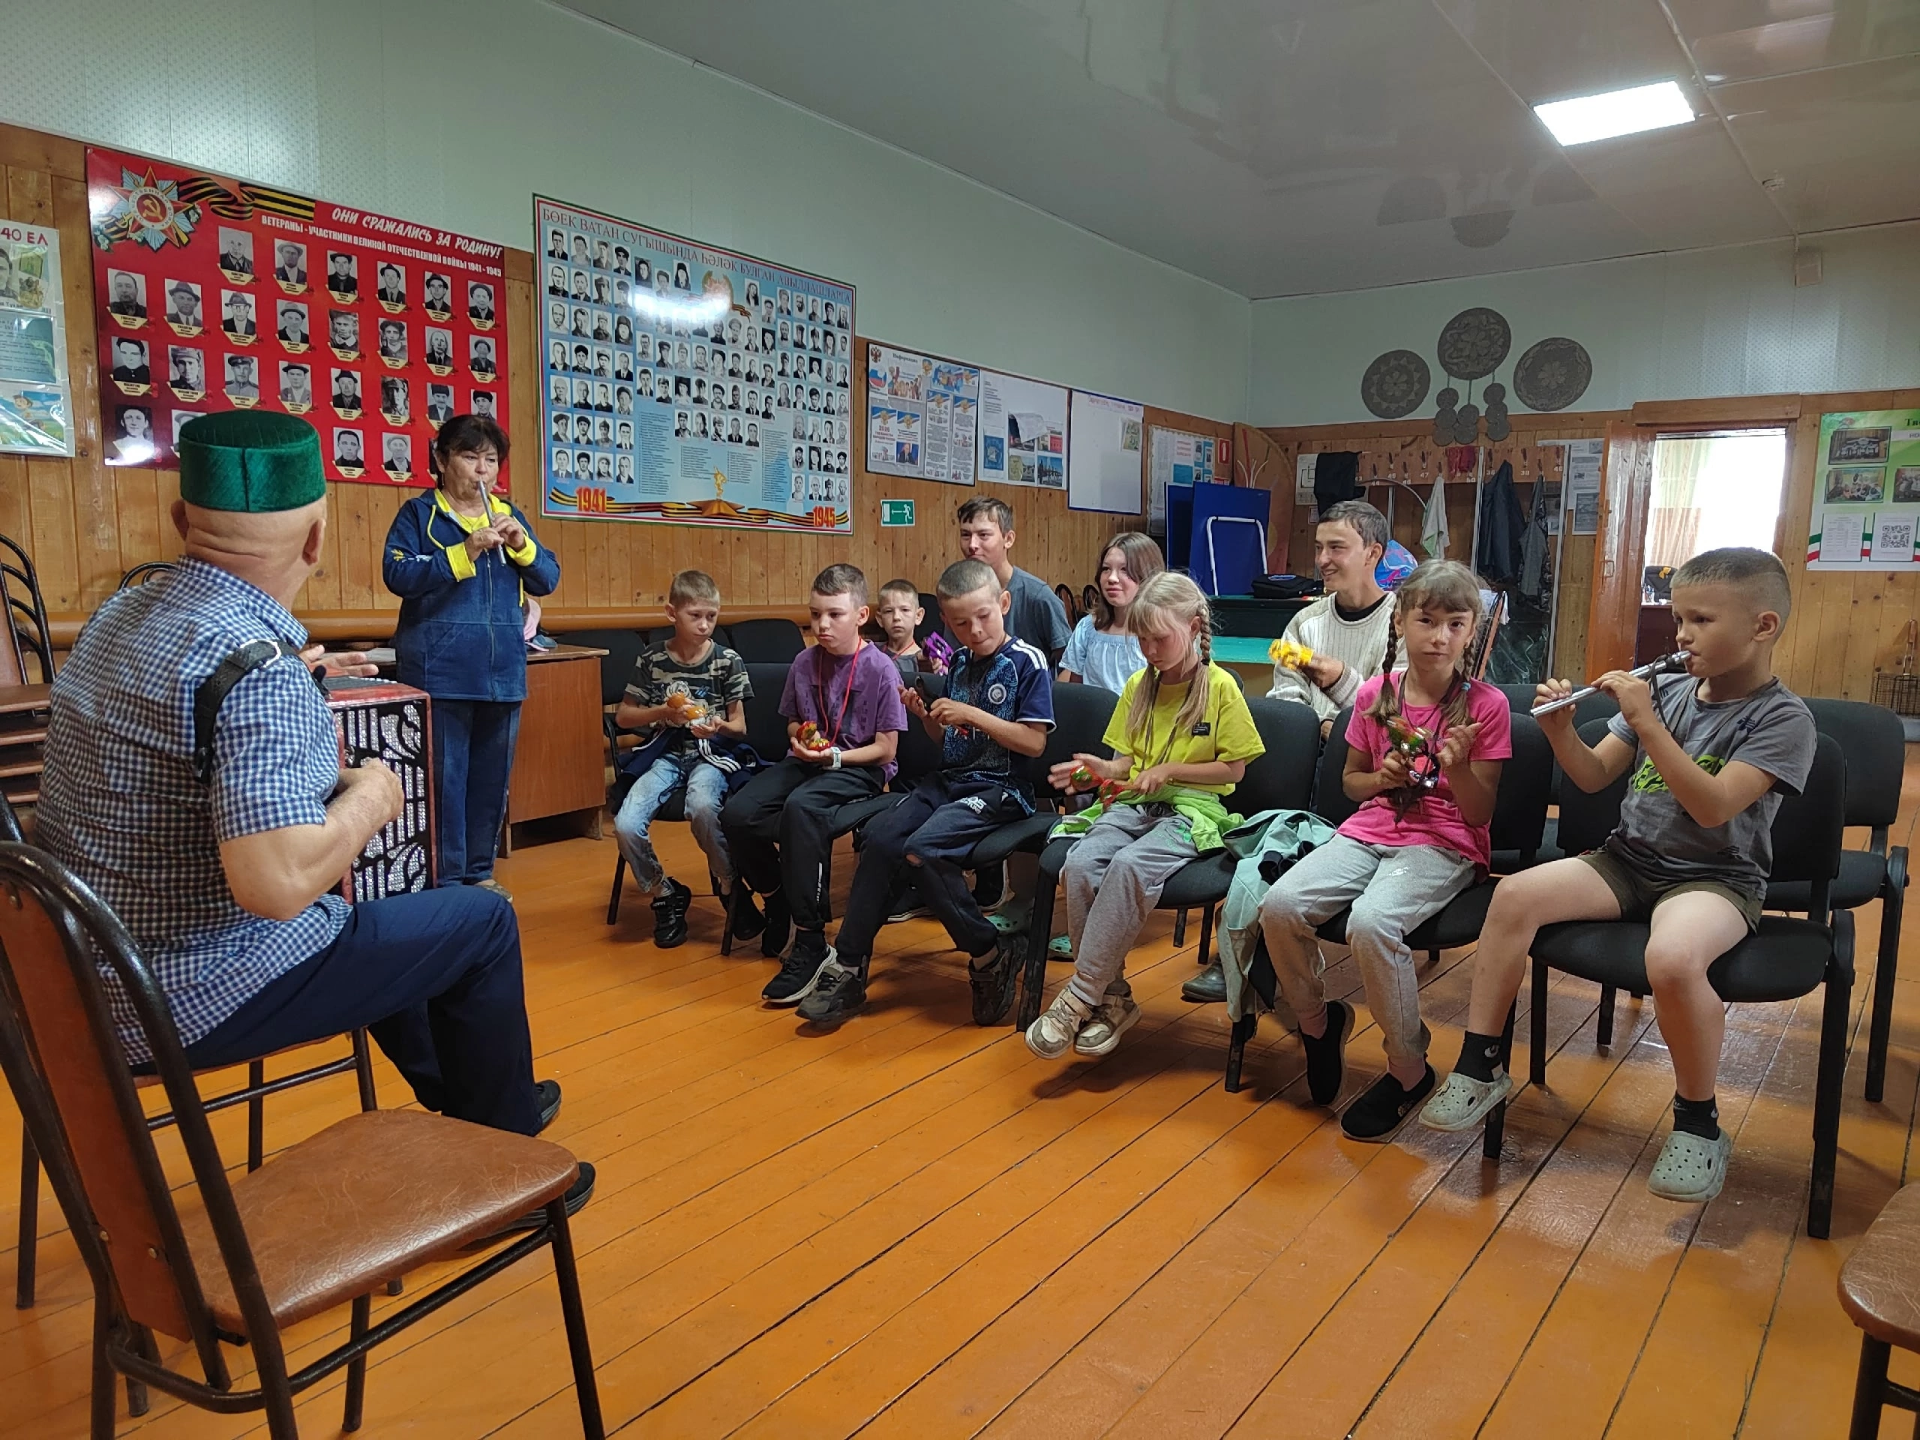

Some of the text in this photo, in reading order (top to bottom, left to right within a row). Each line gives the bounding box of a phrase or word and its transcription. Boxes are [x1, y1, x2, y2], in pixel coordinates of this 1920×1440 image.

[27, 231, 49, 246] ЕЛ
[261, 214, 304, 233] ВЕТЕРАНЫ
[308, 225, 353, 244] УЧАСТНИКИ
[353, 235, 387, 251] ВЕЛИКОЙ
[387, 243, 442, 264] ОТЕЧЕСТВЕННОЙ
[442, 255, 467, 270] ВОЙНЫ
[468, 261, 482, 273] 1941
[486, 266, 502, 278] 1945
[331, 207, 503, 259] ОНИ СРАЖАЛИСЬ ЗА РОДИНУ!
[542, 208, 577, 229] БӨЕК
[579, 218, 619, 240] ВАТАН
[622, 230, 699, 262] СУГЫШЫНДА
[701, 252, 738, 272] ҺӘЛӘК
[740, 263, 775, 283] БУЛГАН
[575, 486, 607, 513] 1941
[812, 505, 836, 528] 1945
